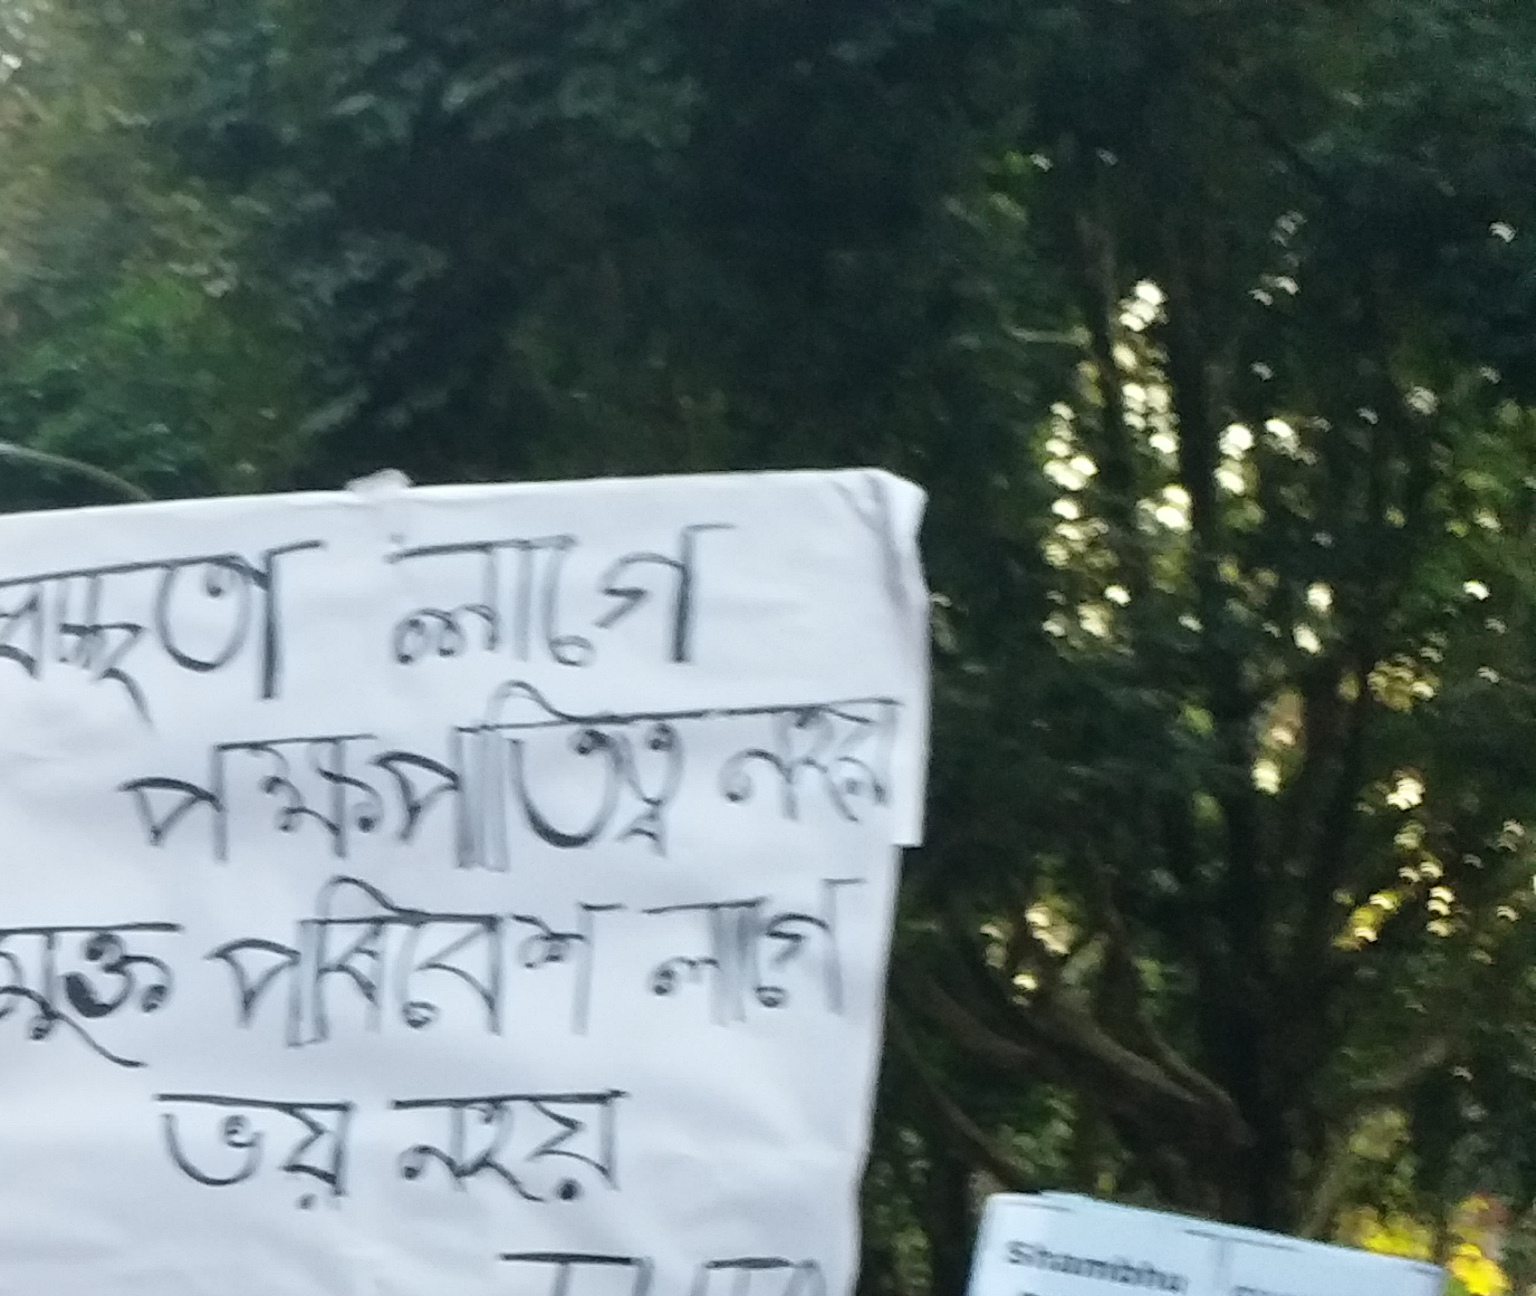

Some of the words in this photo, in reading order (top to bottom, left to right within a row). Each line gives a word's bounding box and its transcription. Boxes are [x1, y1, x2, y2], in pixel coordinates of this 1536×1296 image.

[384, 525, 736, 668] লাগে
[155, 1092, 354, 1207] ভয়
[1006, 1240, 1189, 1295] Shambhu
